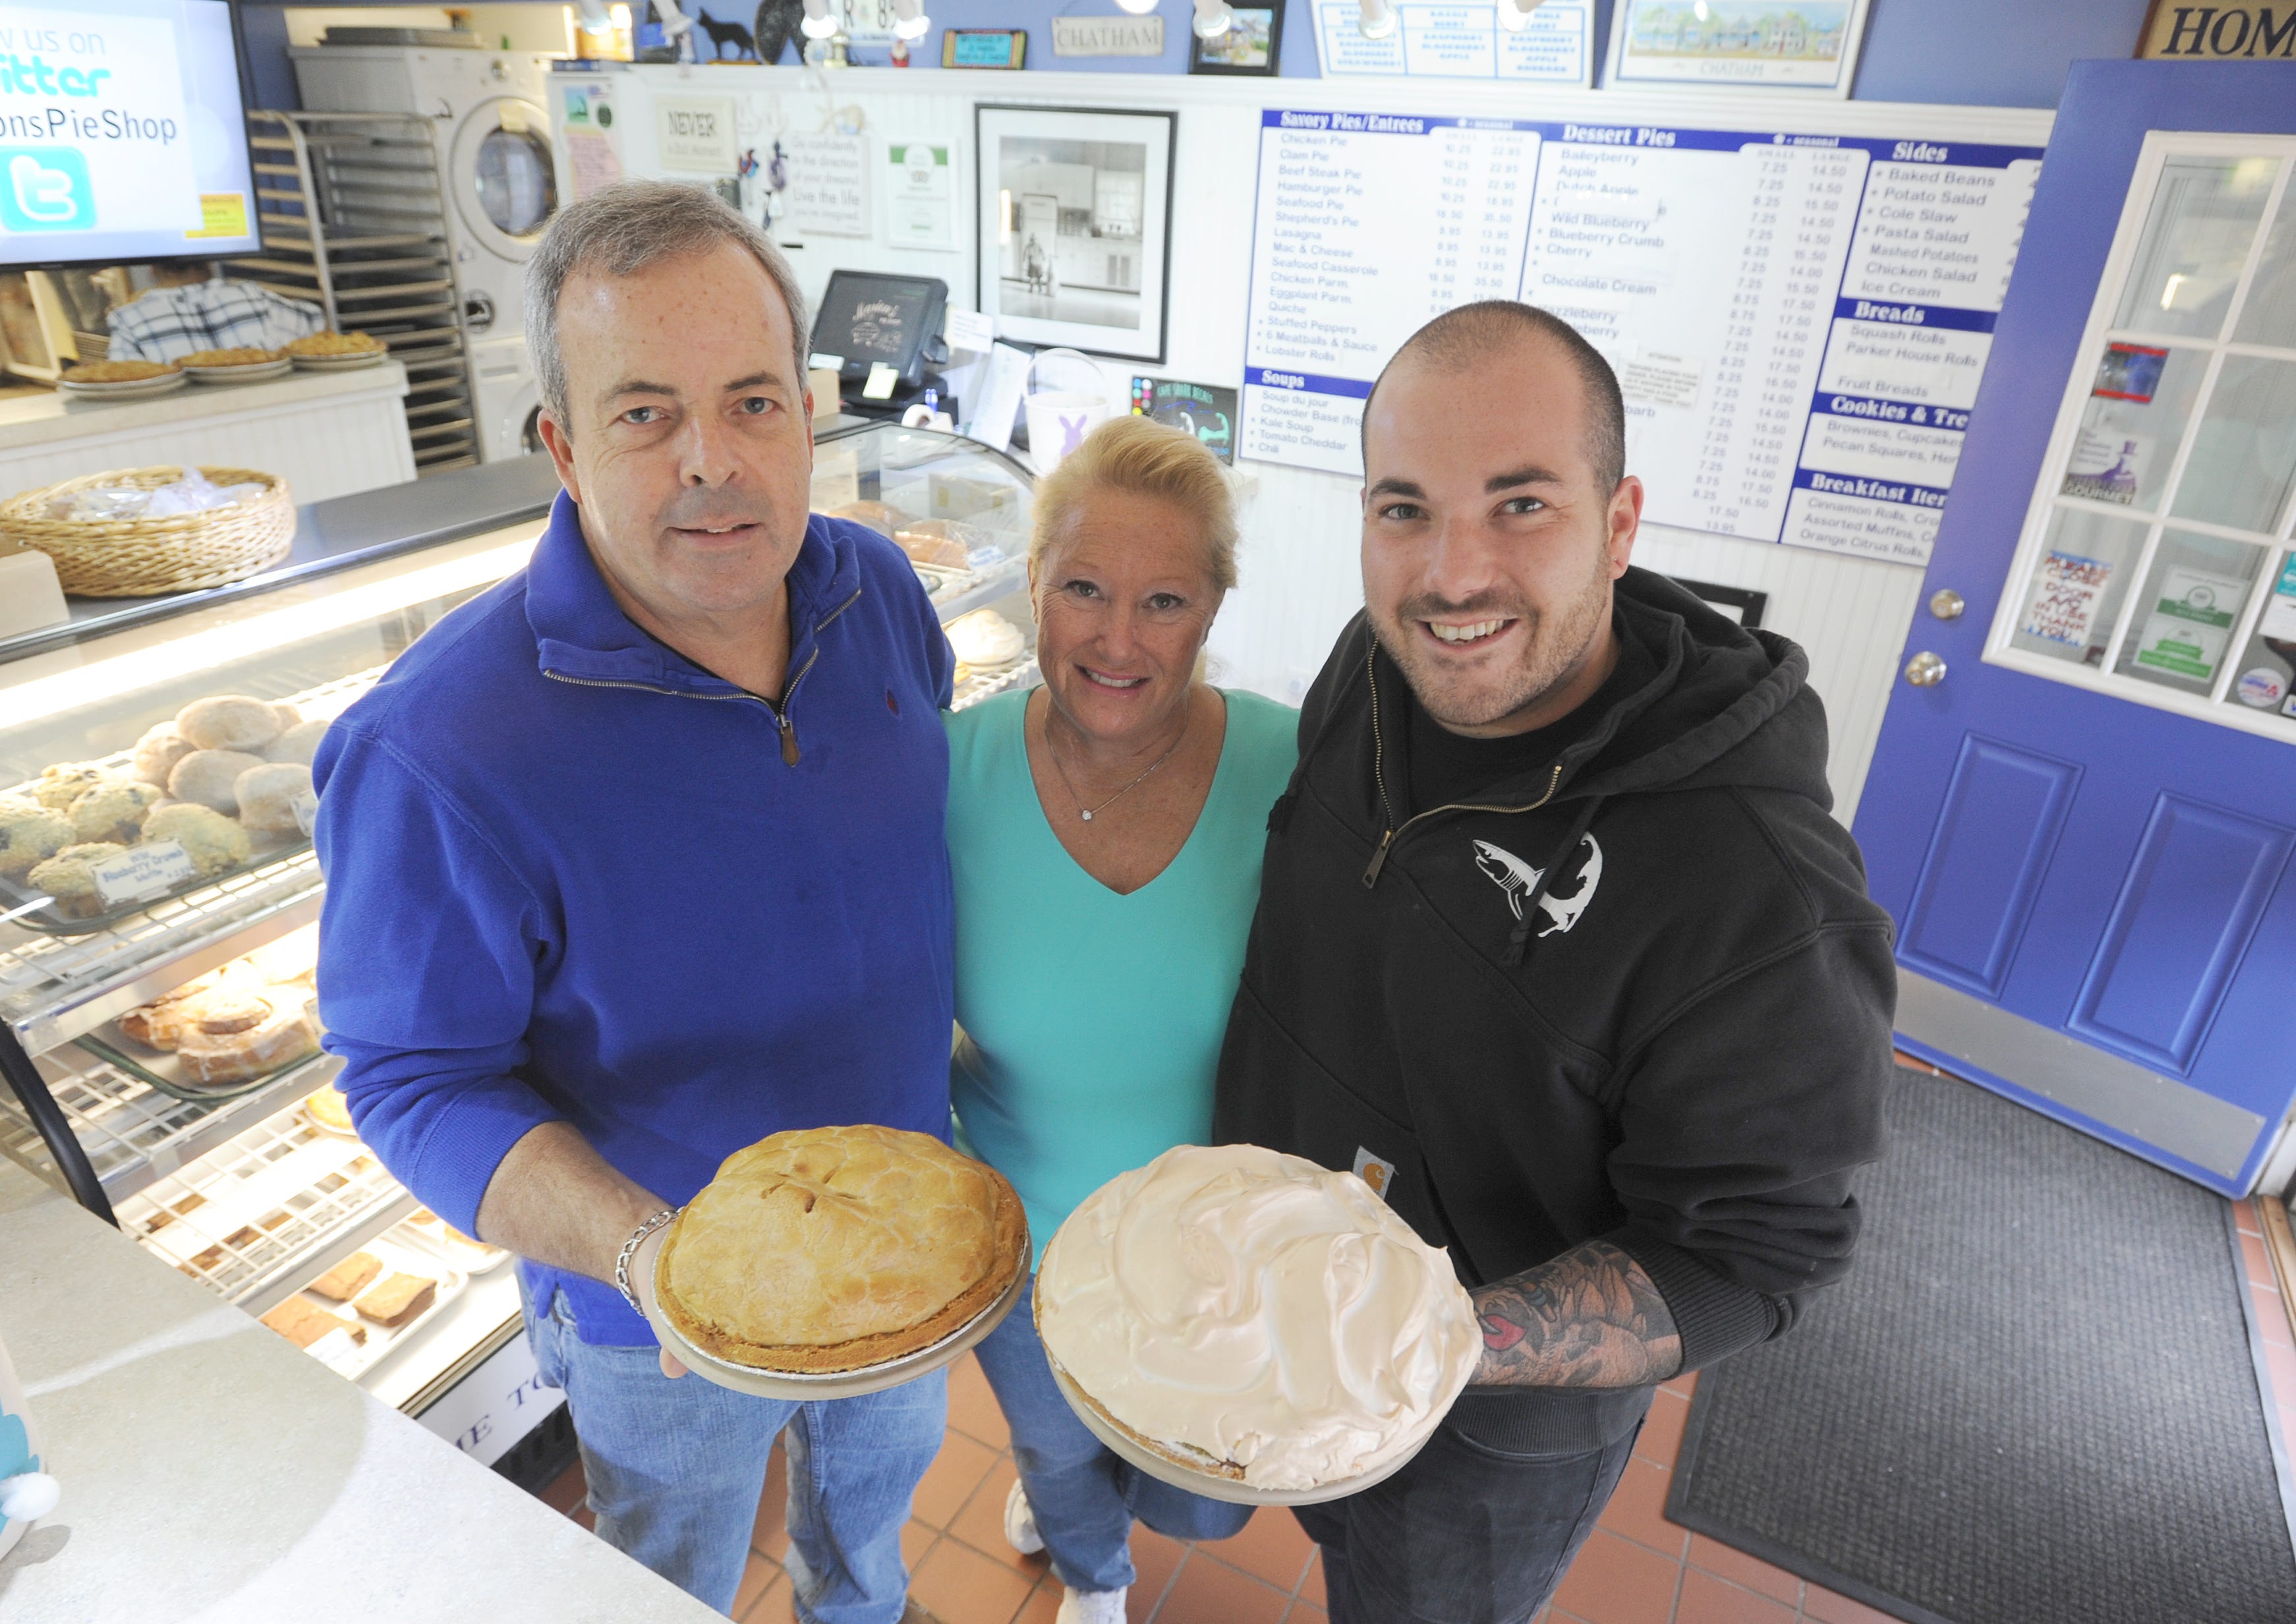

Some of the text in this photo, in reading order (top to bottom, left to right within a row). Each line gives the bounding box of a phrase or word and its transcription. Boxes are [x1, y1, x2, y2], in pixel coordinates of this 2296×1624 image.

[24, 28, 60, 53] us
[68, 32, 106, 55] on
[1056, 27, 1160, 47] CHATHAM
[1699, 61, 1764, 76] CHATHAM
[668, 110, 718, 137] NEVER
[1280, 111, 1424, 134] Savory Pies/Entrees
[1281, 132, 1348, 146] Chicken Pie
[1562, 123, 1677, 147] Dessert Pies
[1280, 149, 1329, 161] Clam Pie
[1561, 148, 1639, 165] Baileyberry
[1891, 142, 1949, 162] Sides
[1279, 165, 1362, 180] Beef Steak Pie
[1558, 165, 1597, 178] Apple
[1889, 167, 1995, 187] Baked Beans
[818, 187, 837, 205] the
[840, 188, 860, 206] life
[1277, 181, 1363, 196] Hamburger Pie
[1883, 187, 1988, 206] Potato Salad
[1277, 196, 1344, 210] Seafood Pie
[1275, 212, 1360, 227] Shepherd's Pie
[1551, 212, 1651, 233] Wild Blueberry
[1880, 206, 1959, 223] Cole Slaw
[1274, 227, 1322, 241] Lasagna
[1549, 227, 1665, 248] Blueberry Crumb
[1875, 225, 1970, 244] Pasta Salad
[1273, 242, 1354, 258] Mac & Cheese
[1546, 243, 1592, 258] Cherry
[1870, 243, 1980, 264] Mashed Potatoes
[1272, 256, 1379, 276] Seafood Casserole
[1865, 262, 1978, 283] Chicken Salad
[1271, 272, 1314, 285] Chicken
[1541, 272, 1658, 295] Chocolate Cream
[1269, 287, 1318, 301] Eggplant
[1862, 280, 1941, 298] Ice Cream
[1269, 301, 1307, 314] Quiche
[1854, 301, 1925, 324] Breads
[1268, 316, 1358, 335] Stuffed Peppers
[1267, 331, 1378, 351] 6 Meatballs & Sauce
[1850, 326, 1946, 345] Squash Rolls
[1265, 345, 1336, 362] Lobster Rolls
[1845, 343, 1978, 368] Parker House Rolls
[1262, 370, 1305, 389] Soups
[1837, 375, 1930, 398] Fruit Breads
[1263, 391, 1329, 408] Soup du jour
[1261, 403, 1308, 417] Chowder
[1312, 411, 1339, 422] Base
[1831, 395, 1907, 420] Cookies
[1911, 407, 1927, 424] &
[1260, 417, 1313, 433] Kale Soup
[1827, 420, 1893, 440] Brownies,
[1259, 429, 1346, 451] Tomato Cheddar
[1259, 442, 1280, 453] Chili
[1823, 436, 1866, 453] Pecan
[1868, 442, 1925, 463] Squares,
[1810, 473, 1907, 503] Breakfast
[1808, 496, 1872, 517] Cinnamon
[1804, 513, 1862, 532] Assorted
[1800, 528, 1847, 546] Orange
[1851, 535, 1889, 551] Citrus
[2046, 582, 2094, 600] DOOR
[2035, 601, 2088, 621] IN USE
[2048, 594, 2081, 610] A/C
[2032, 610, 2086, 633] THANK
[2038, 625, 2072, 639] YOU
